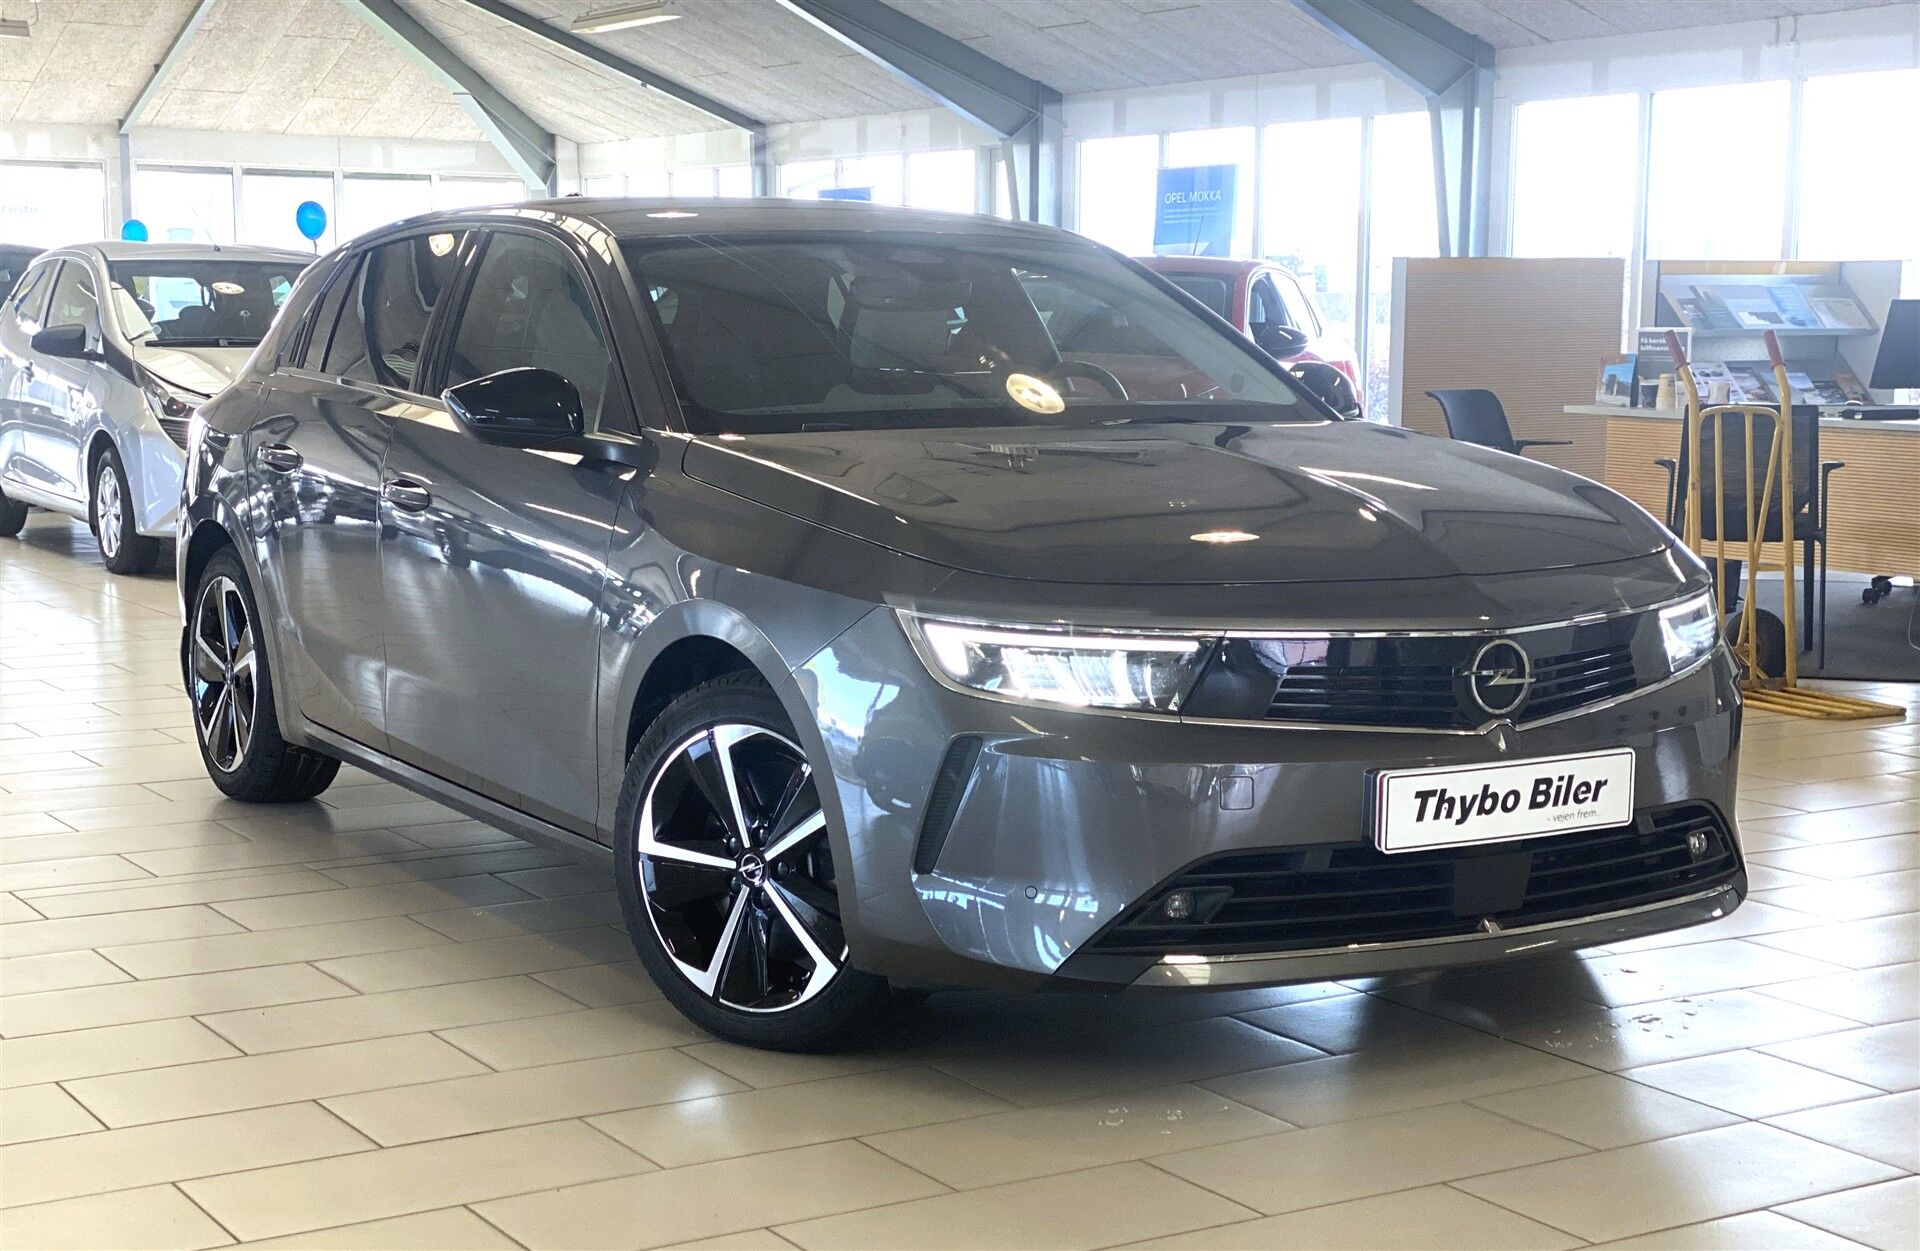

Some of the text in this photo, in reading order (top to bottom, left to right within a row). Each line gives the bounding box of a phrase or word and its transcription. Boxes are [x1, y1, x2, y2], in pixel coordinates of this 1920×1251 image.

[1165, 190, 1221, 204] OPEL MOKKA
[1414, 774, 1609, 826] Thybo Biler
[1553, 812, 1575, 823] vejen
